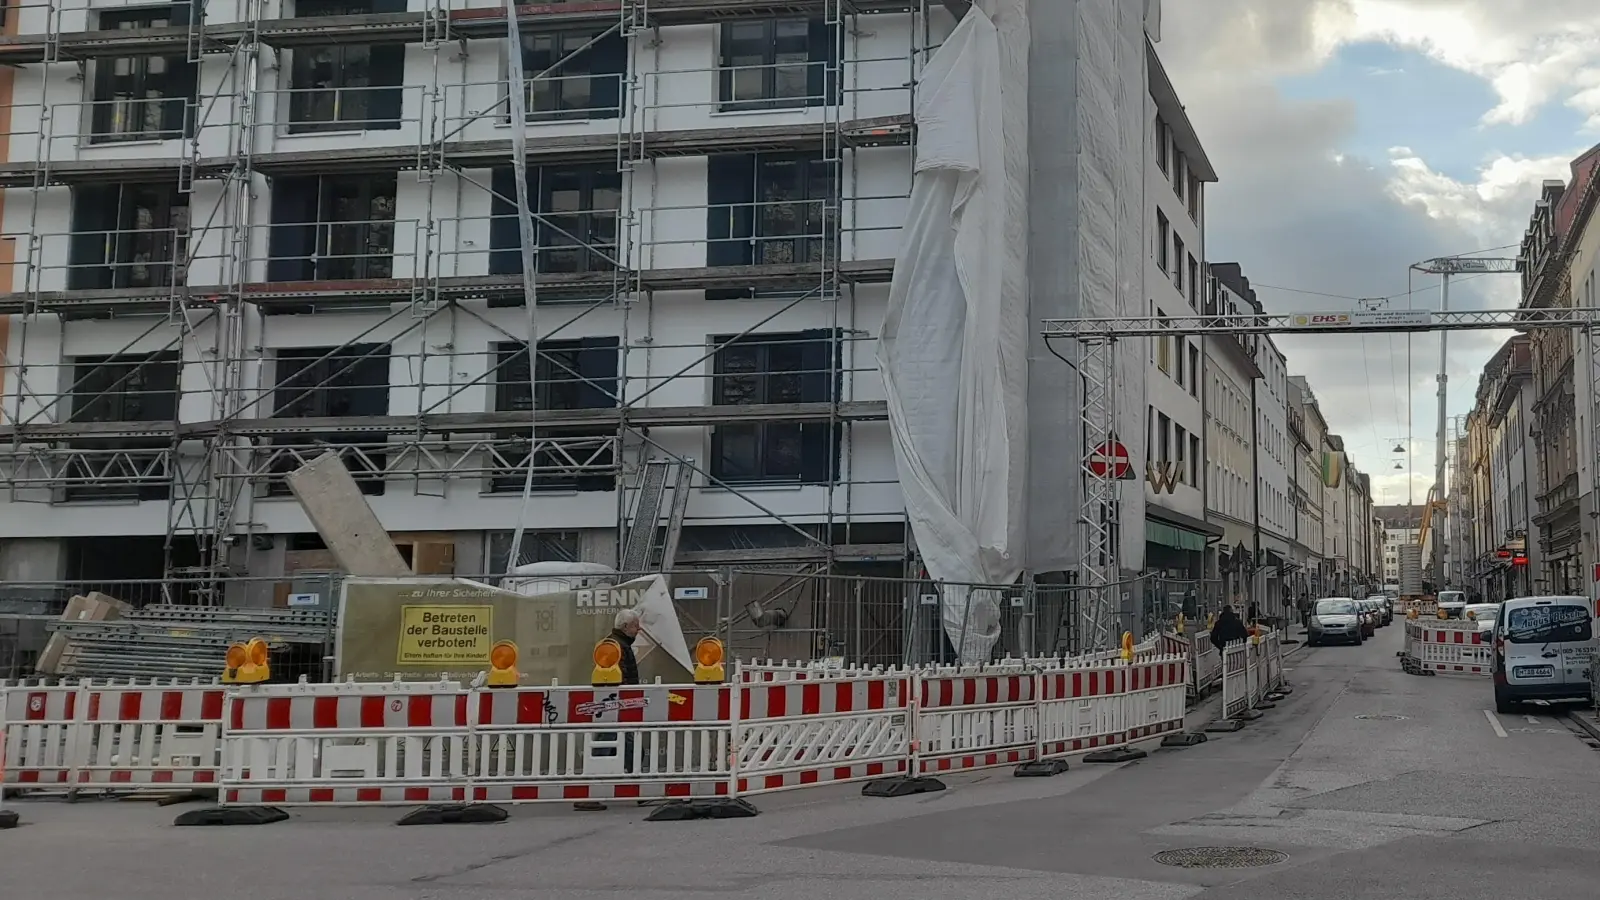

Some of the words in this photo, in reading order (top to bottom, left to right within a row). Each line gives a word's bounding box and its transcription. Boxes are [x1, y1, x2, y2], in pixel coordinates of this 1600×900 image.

[1312, 314, 1337, 323] EHS
[412, 590, 423, 598] zu
[426, 588, 450, 598] Ihrer
[423, 612, 476, 623] Betreten
[407, 625, 428, 635] der
[432, 624, 488, 635] Baustelle
[418, 637, 477, 648] verboten!
